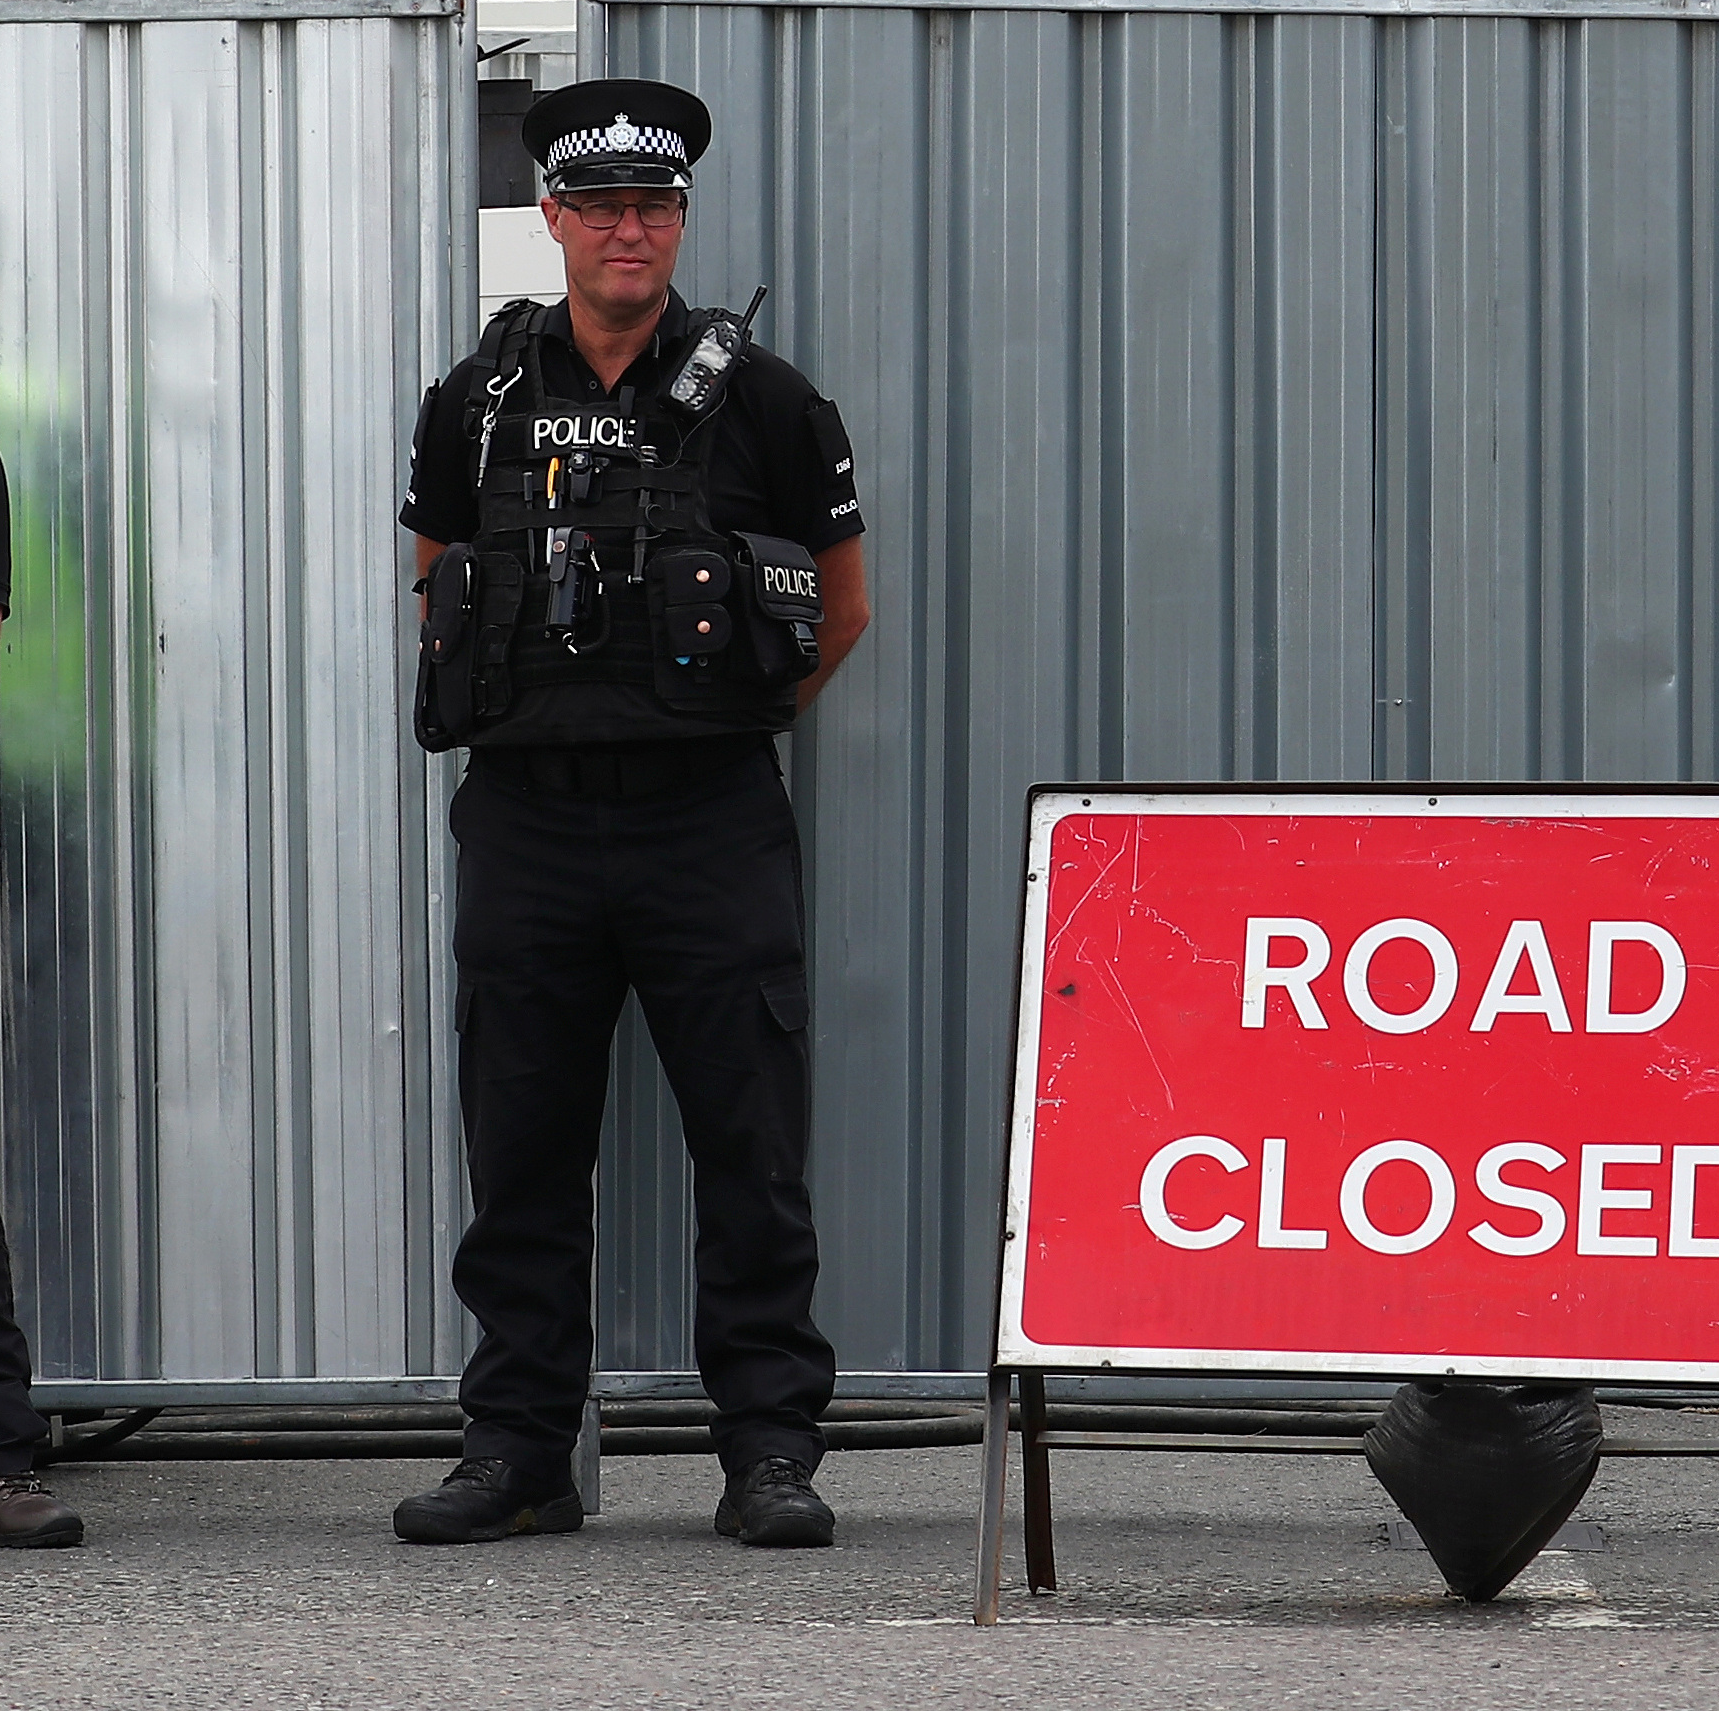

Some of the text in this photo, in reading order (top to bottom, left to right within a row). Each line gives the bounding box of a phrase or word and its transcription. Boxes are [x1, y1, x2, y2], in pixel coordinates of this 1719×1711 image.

[533, 416, 637, 450] POLICE
[763, 565, 818, 598] POLICE
[1240, 916, 1688, 1035] ROAD
